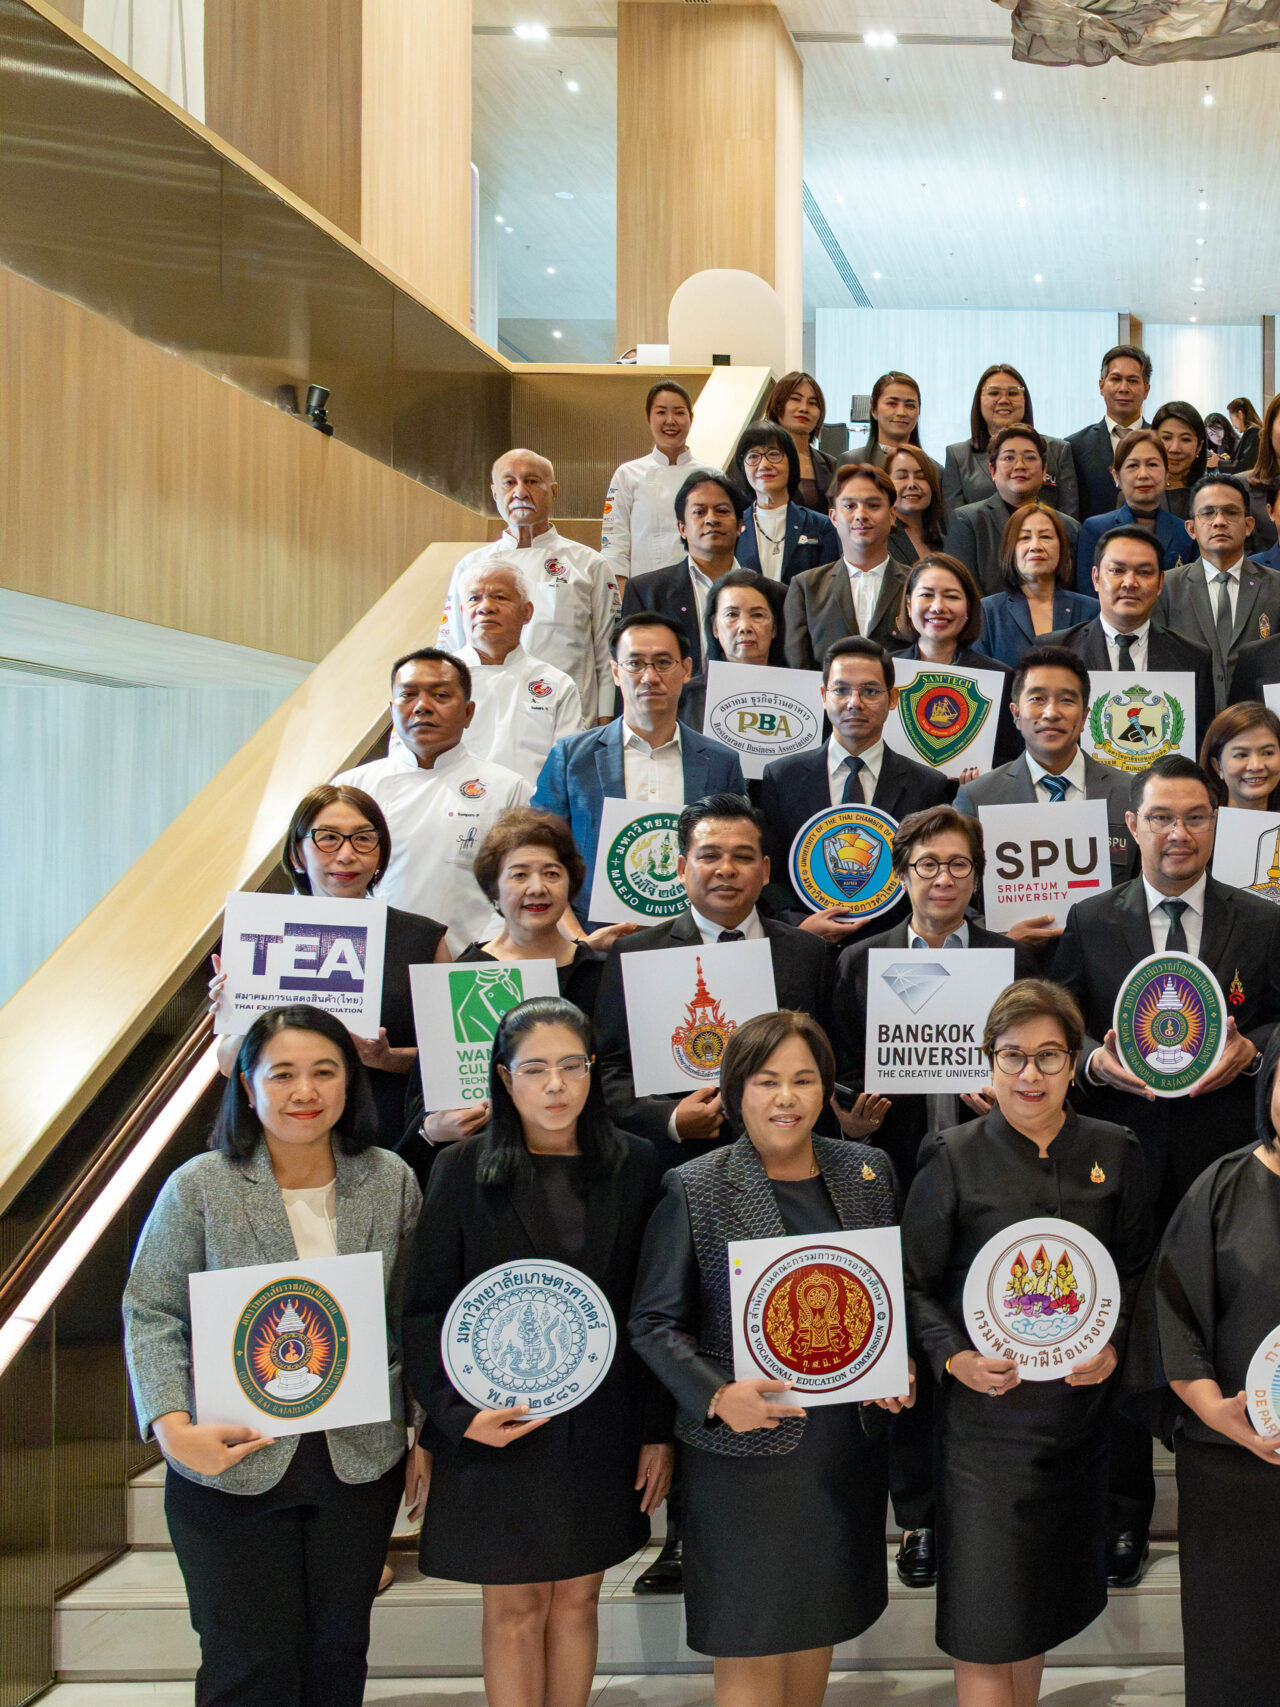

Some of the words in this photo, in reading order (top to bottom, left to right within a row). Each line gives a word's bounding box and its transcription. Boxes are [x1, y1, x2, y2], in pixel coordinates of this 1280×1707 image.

[713, 722, 746, 749] Restaurant
[746, 744, 776, 754] Business
[777, 732, 814, 753] Association
[824, 816, 837, 826] THE
[838, 814, 853, 822] THAI
[995, 836, 1098, 880] SPU
[610, 868, 640, 906] MAEJO
[997, 880, 1059, 893] SRIPATUM
[997, 891, 1068, 904] UNIVERSITY
[239, 930, 366, 981] TEA
[878, 1024, 975, 1043] BANGKOK
[877, 1046, 984, 1066] UNIVERSIT
[877, 1069, 896, 1078] THE
[898, 1069, 943, 1078] CREATIVE
[945, 1068, 992, 1078] UNIVERSI
[1120, 1021, 1131, 1043] SUAN
[1127, 1046, 1156, 1084] SUNANDHA
[1160, 1067, 1201, 1089] RAJABHAT
[1198, 1022, 1219, 1065] UNIVERSITY
[456, 1270, 609, 1344] มหาวิทยาลัยเกษตรศาสตร์
[973, 1297, 1113, 1368] กรมพัฒนาฝีมือแรงงาน
[753, 1336, 794, 1382] VOCATIONAL
[795, 1372, 848, 1387] EDUCATION
[849, 1324, 886, 1375] COMMISSION
[238, 1371, 258, 1399] CHIANG
[256, 1395, 270, 1410] RAI
[272, 1401, 315, 1416] RAJABHAT
[316, 1357, 346, 1402] UNIVERSITY
